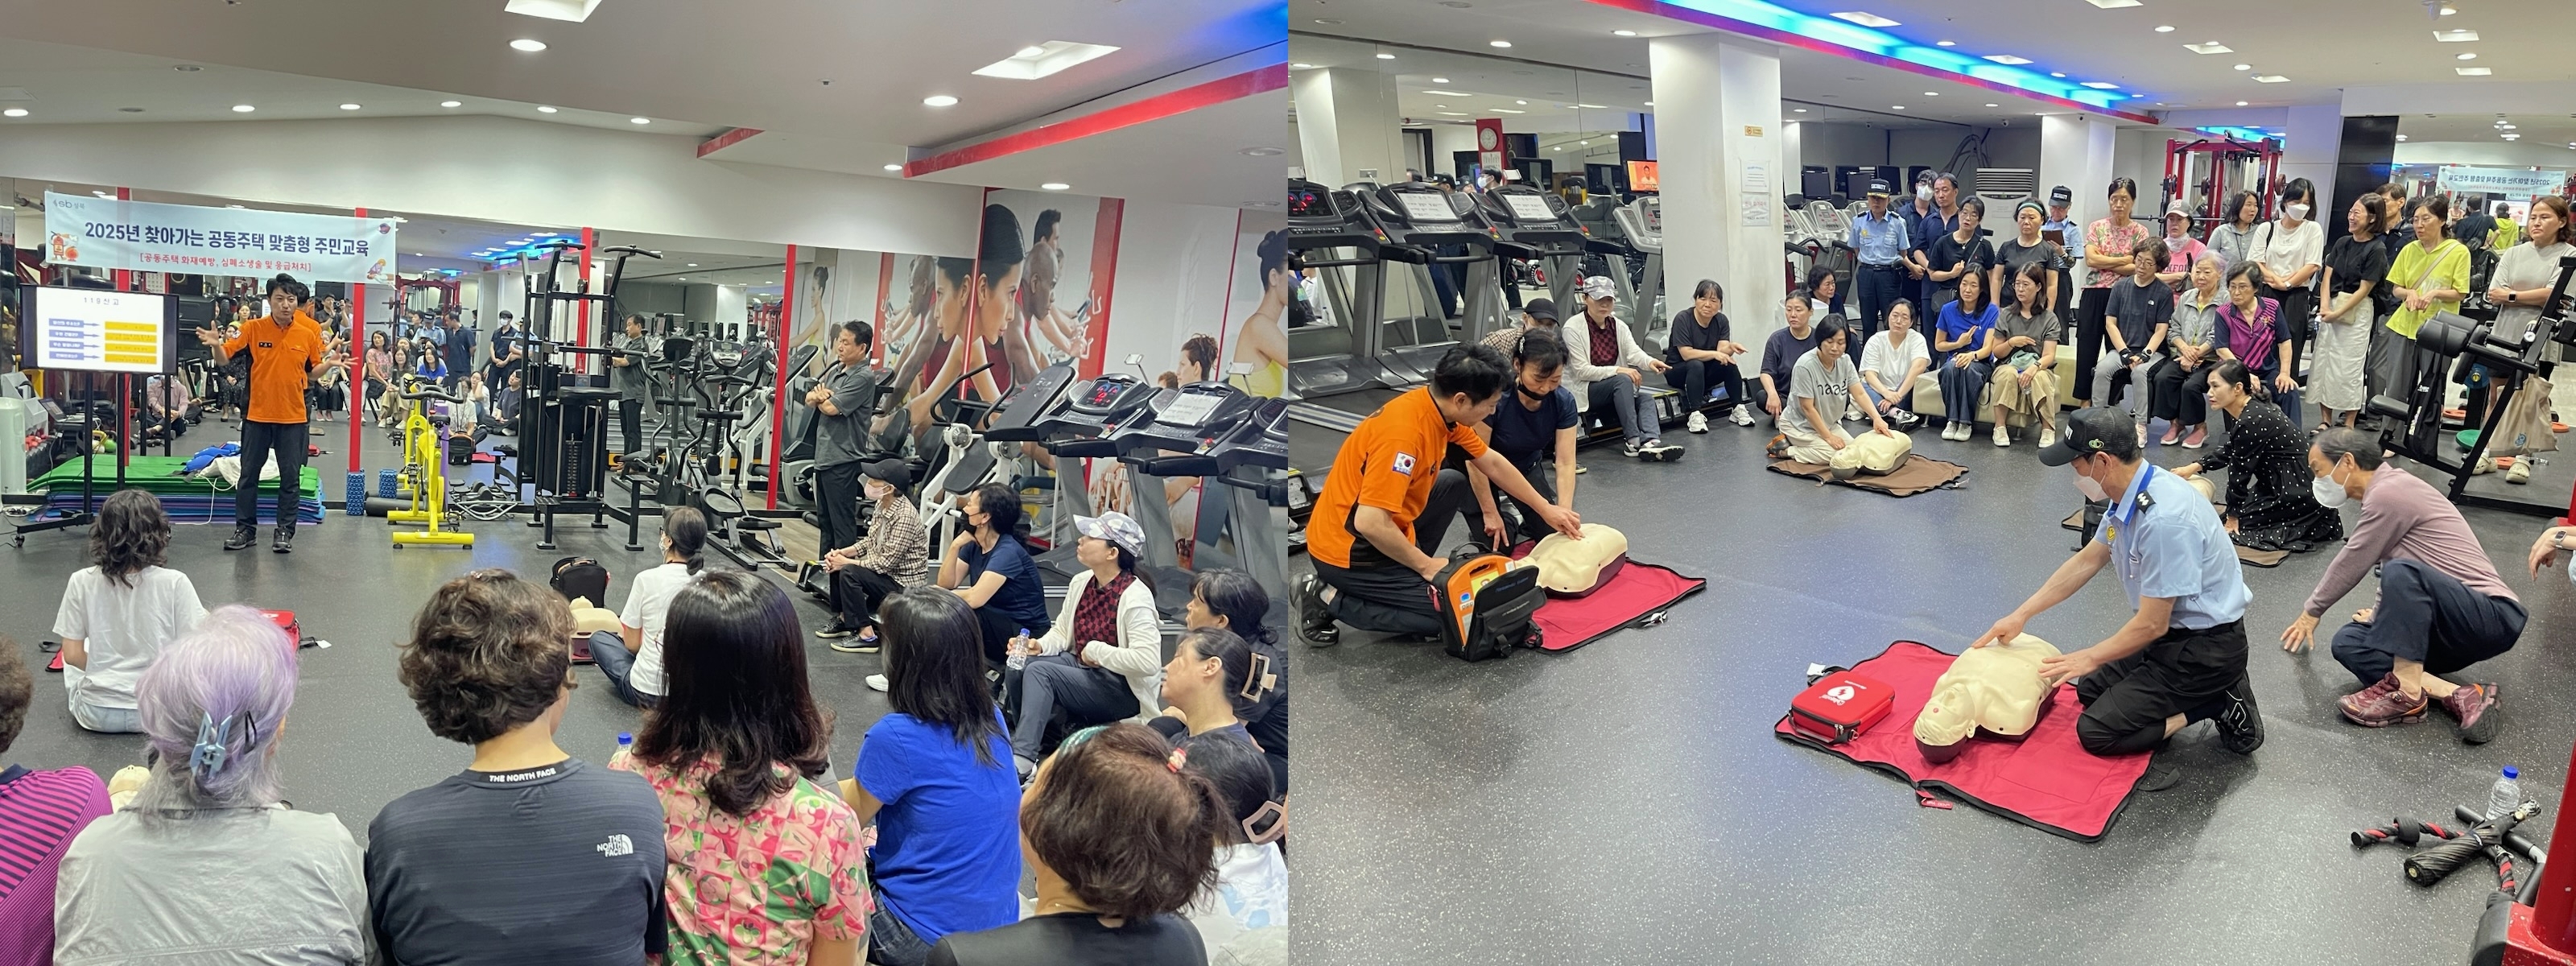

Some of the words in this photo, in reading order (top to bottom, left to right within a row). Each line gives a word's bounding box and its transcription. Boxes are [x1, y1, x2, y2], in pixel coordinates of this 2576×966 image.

[85, 221, 140, 242] 2025년
[145, 225, 204, 247] 찾아가는
[208, 230, 265, 250] 공동주택
[269, 234, 310, 253] 맞춤형
[315, 237, 369, 257] 주민교육
[140, 253, 179, 265] [공동주택
[181, 255, 219, 267] 화재예방,
[221, 258, 262, 269] 심폐소생술
[265, 260, 272, 270] 및
[275, 261, 312, 272] 응급처치]
[489, 774, 506, 782] THE
[506, 772, 535, 782] NORTH
[536, 767, 556, 778] FACE
[608, 834, 622, 843] THE
[597, 840, 622, 852] NORTH
[605, 848, 622, 857] FACE
